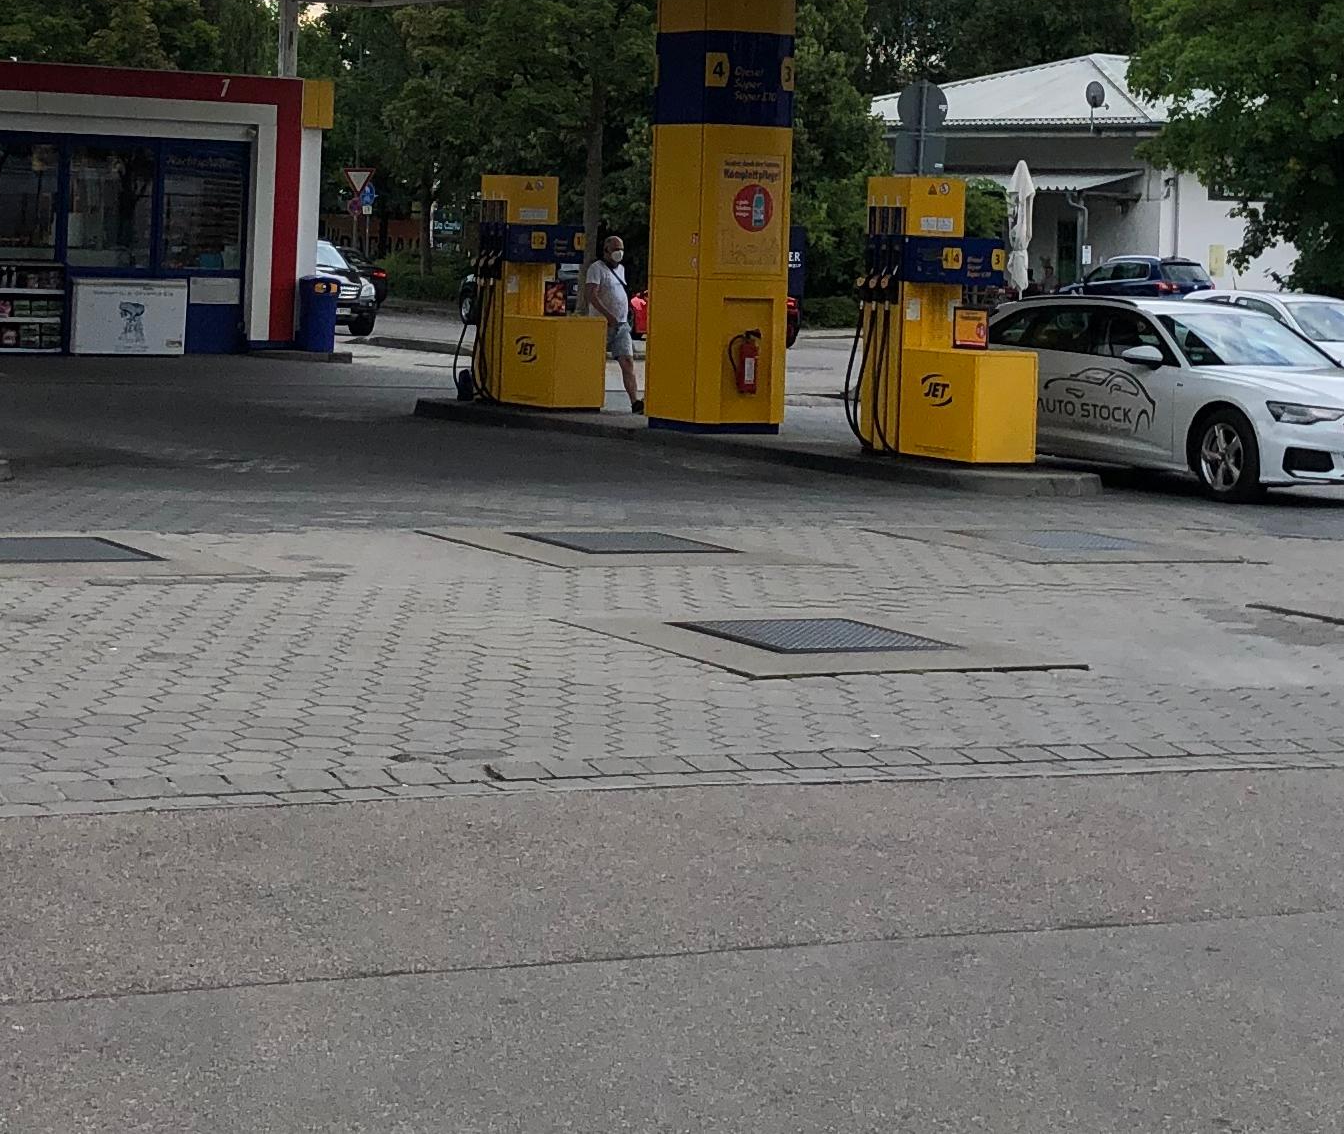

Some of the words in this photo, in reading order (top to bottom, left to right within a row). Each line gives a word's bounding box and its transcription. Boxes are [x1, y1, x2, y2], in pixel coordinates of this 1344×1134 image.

[712, 61, 726, 78] 4
[784, 65, 792, 83] 3
[923, 382, 950, 398] JET
[1080, 403, 1132, 424] STOCK
